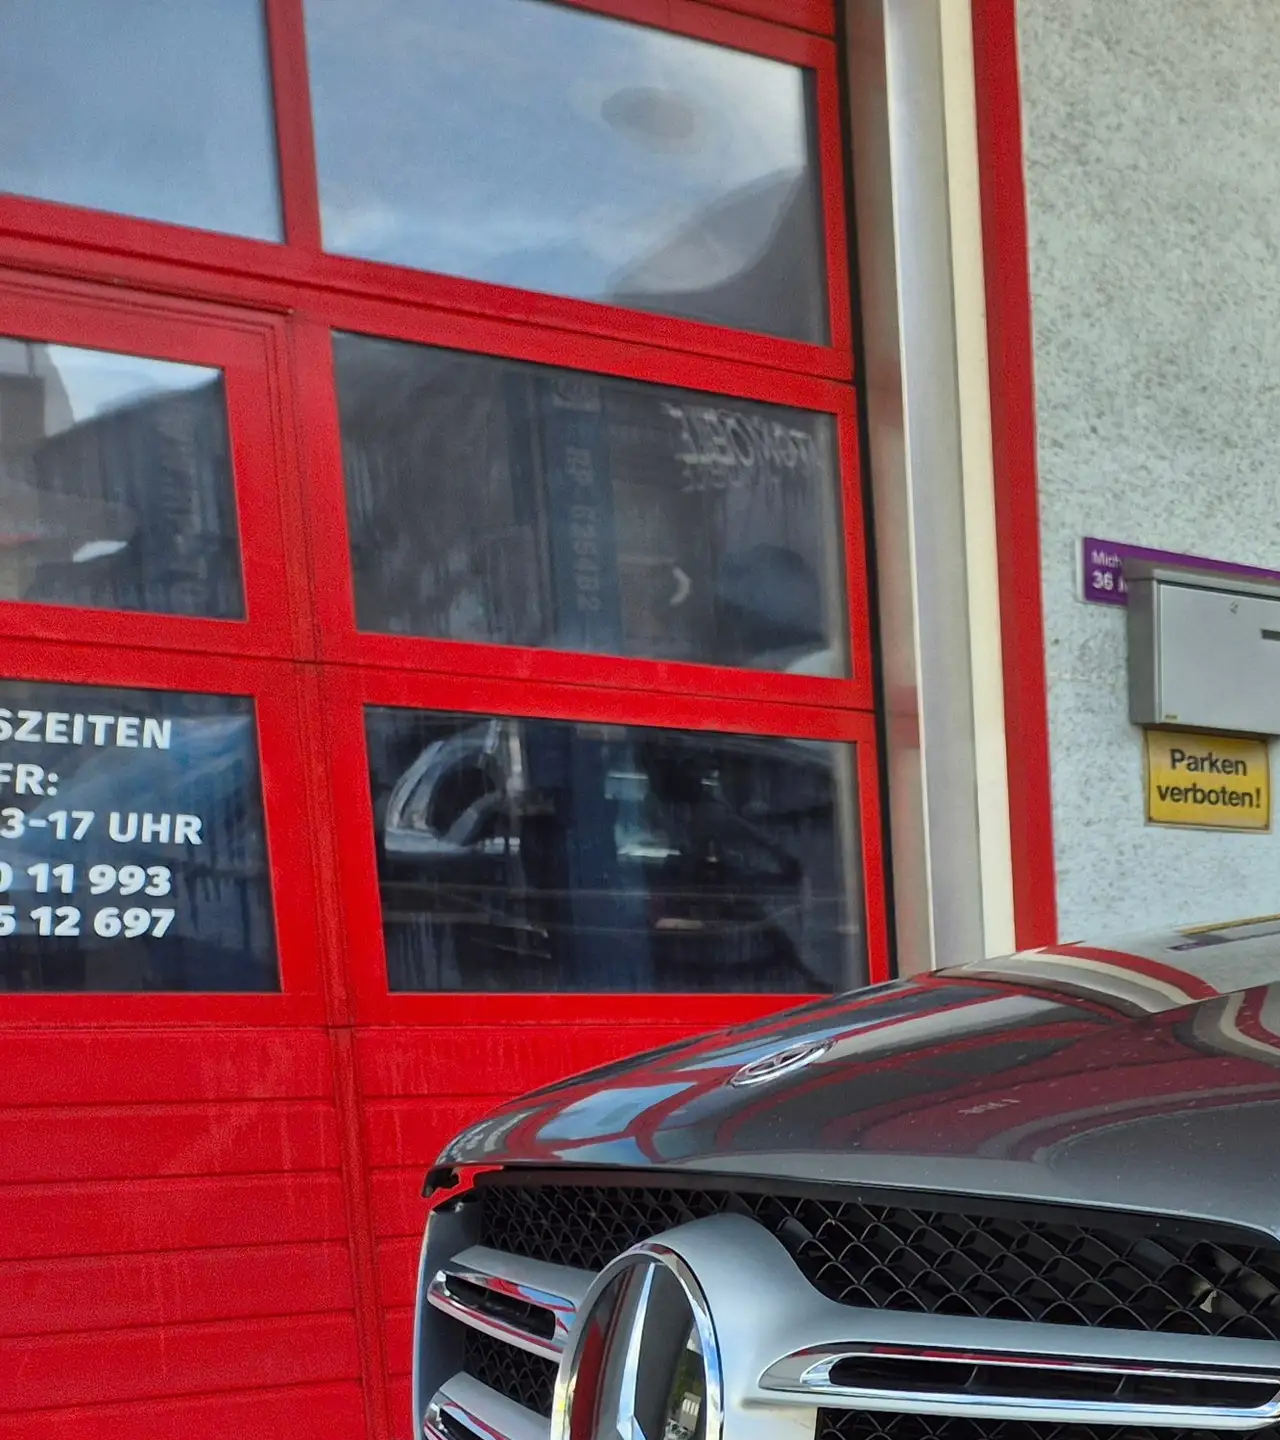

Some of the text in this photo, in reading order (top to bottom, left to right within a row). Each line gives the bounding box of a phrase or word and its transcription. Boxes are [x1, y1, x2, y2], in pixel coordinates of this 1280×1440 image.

[1170, 748, 1247, 776] Parken
[1156, 782, 1262, 809] verboten!
[0, 807, 203, 845] 3-17 UHR
[27, 862, 75, 894] 11
[88, 864, 172, 897] 993
[30, 906, 81, 937] 12
[93, 907, 176, 939] 697
